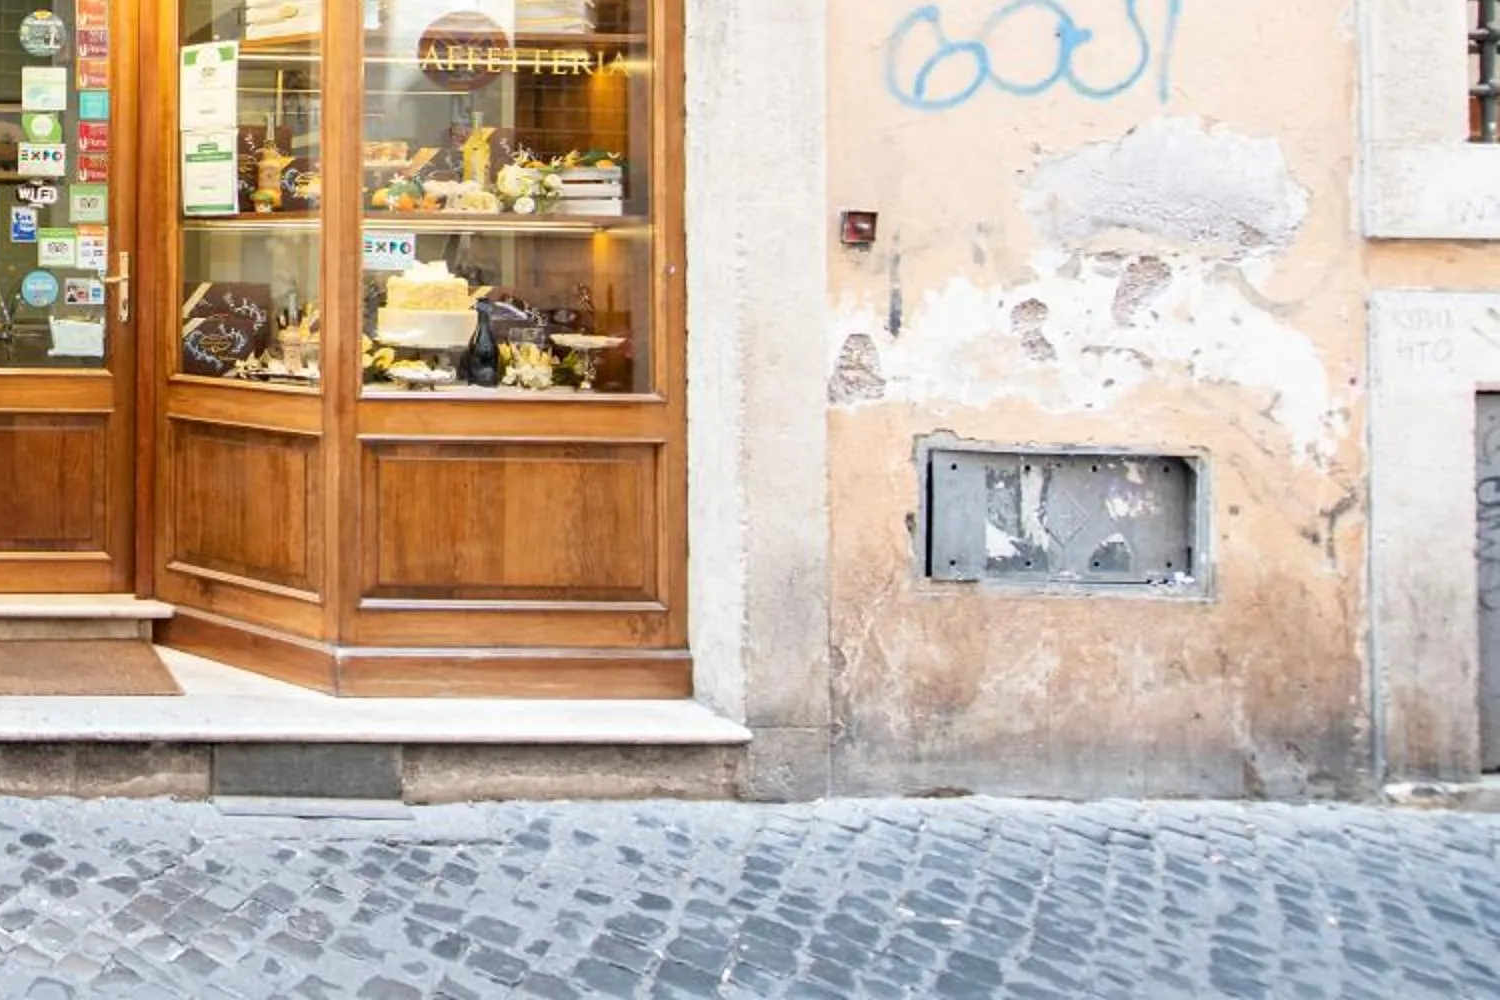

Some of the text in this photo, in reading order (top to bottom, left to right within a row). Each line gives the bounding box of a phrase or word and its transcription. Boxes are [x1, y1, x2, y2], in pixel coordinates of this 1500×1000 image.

[408, 44, 631, 78] AFFETTERIA
[20, 150, 63, 162] EXPO
[363, 240, 413, 256] EXPO
